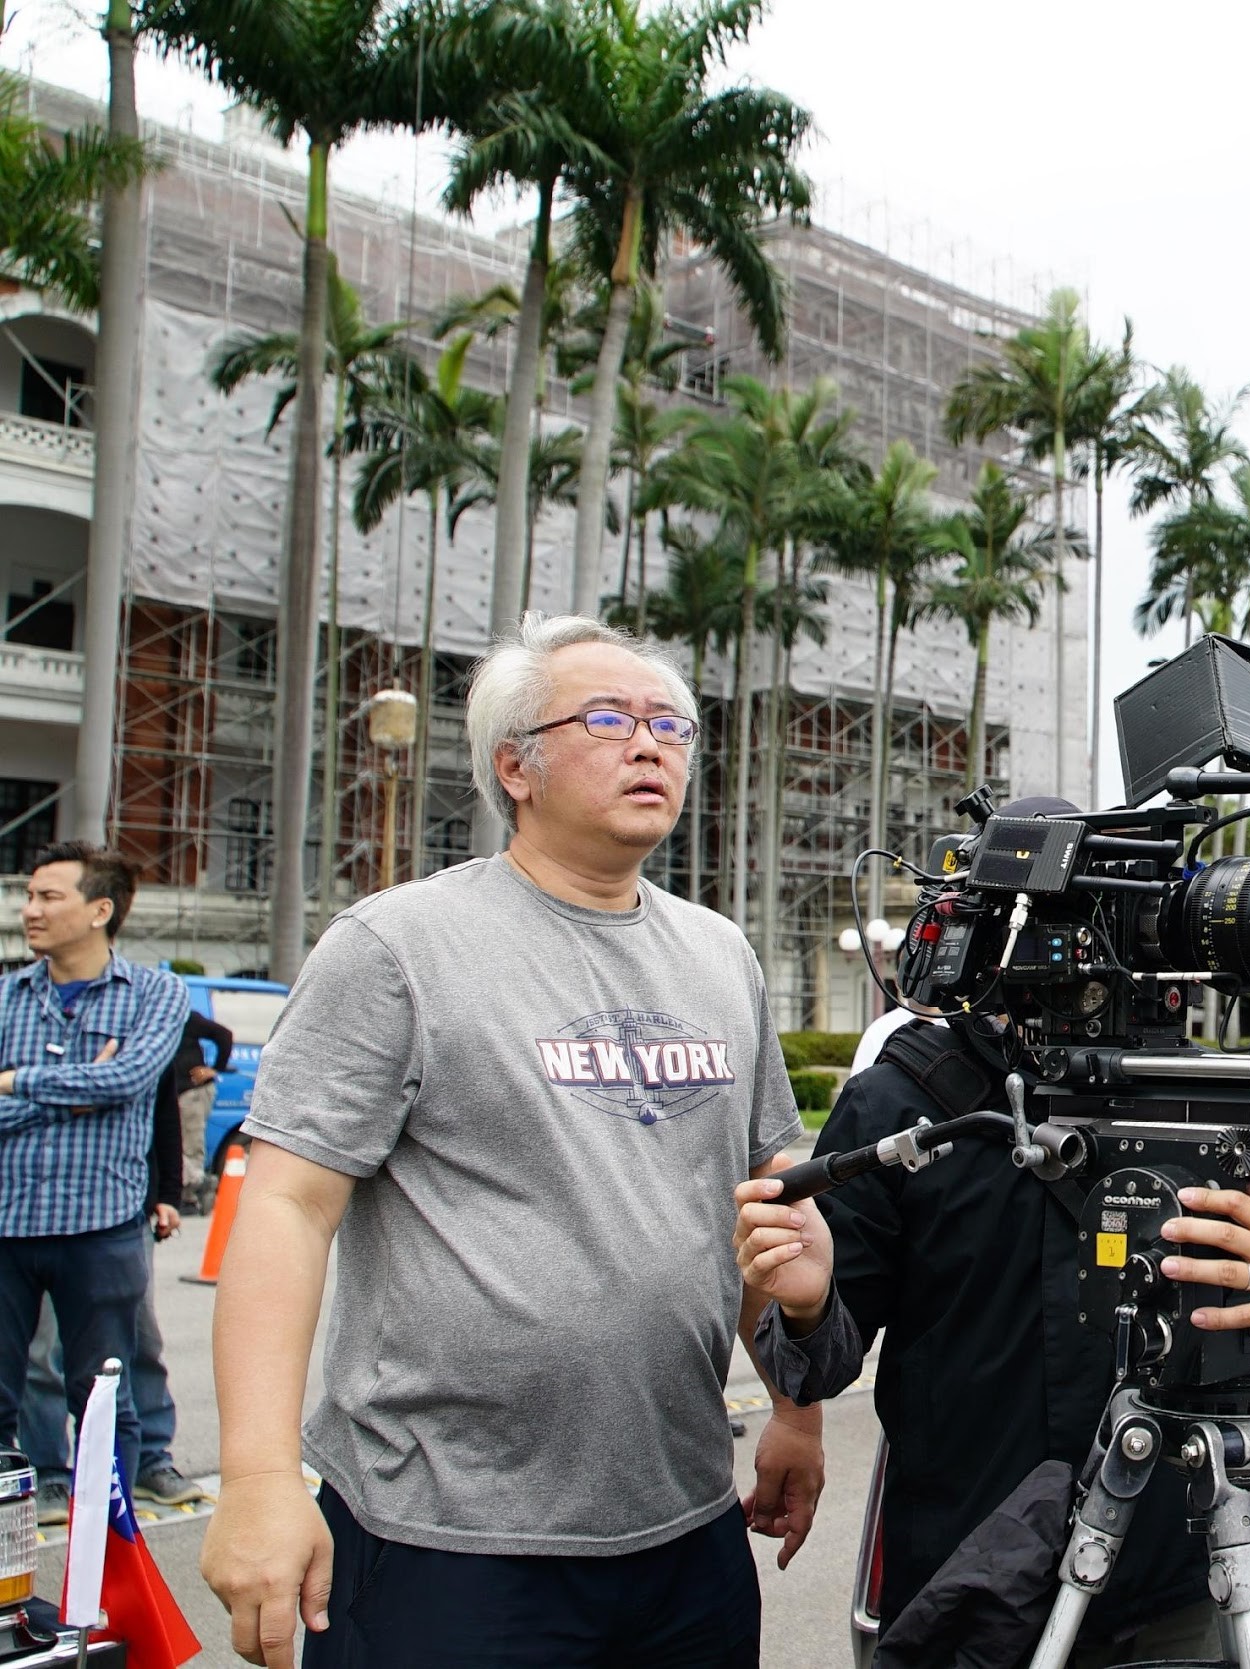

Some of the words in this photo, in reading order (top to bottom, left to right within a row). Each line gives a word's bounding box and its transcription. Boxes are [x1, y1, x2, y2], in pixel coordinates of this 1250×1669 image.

[1060, 842, 1074, 869] SWIT
[537, 1038, 633, 1087] NEW
[633, 1039, 736, 1089] YORK
